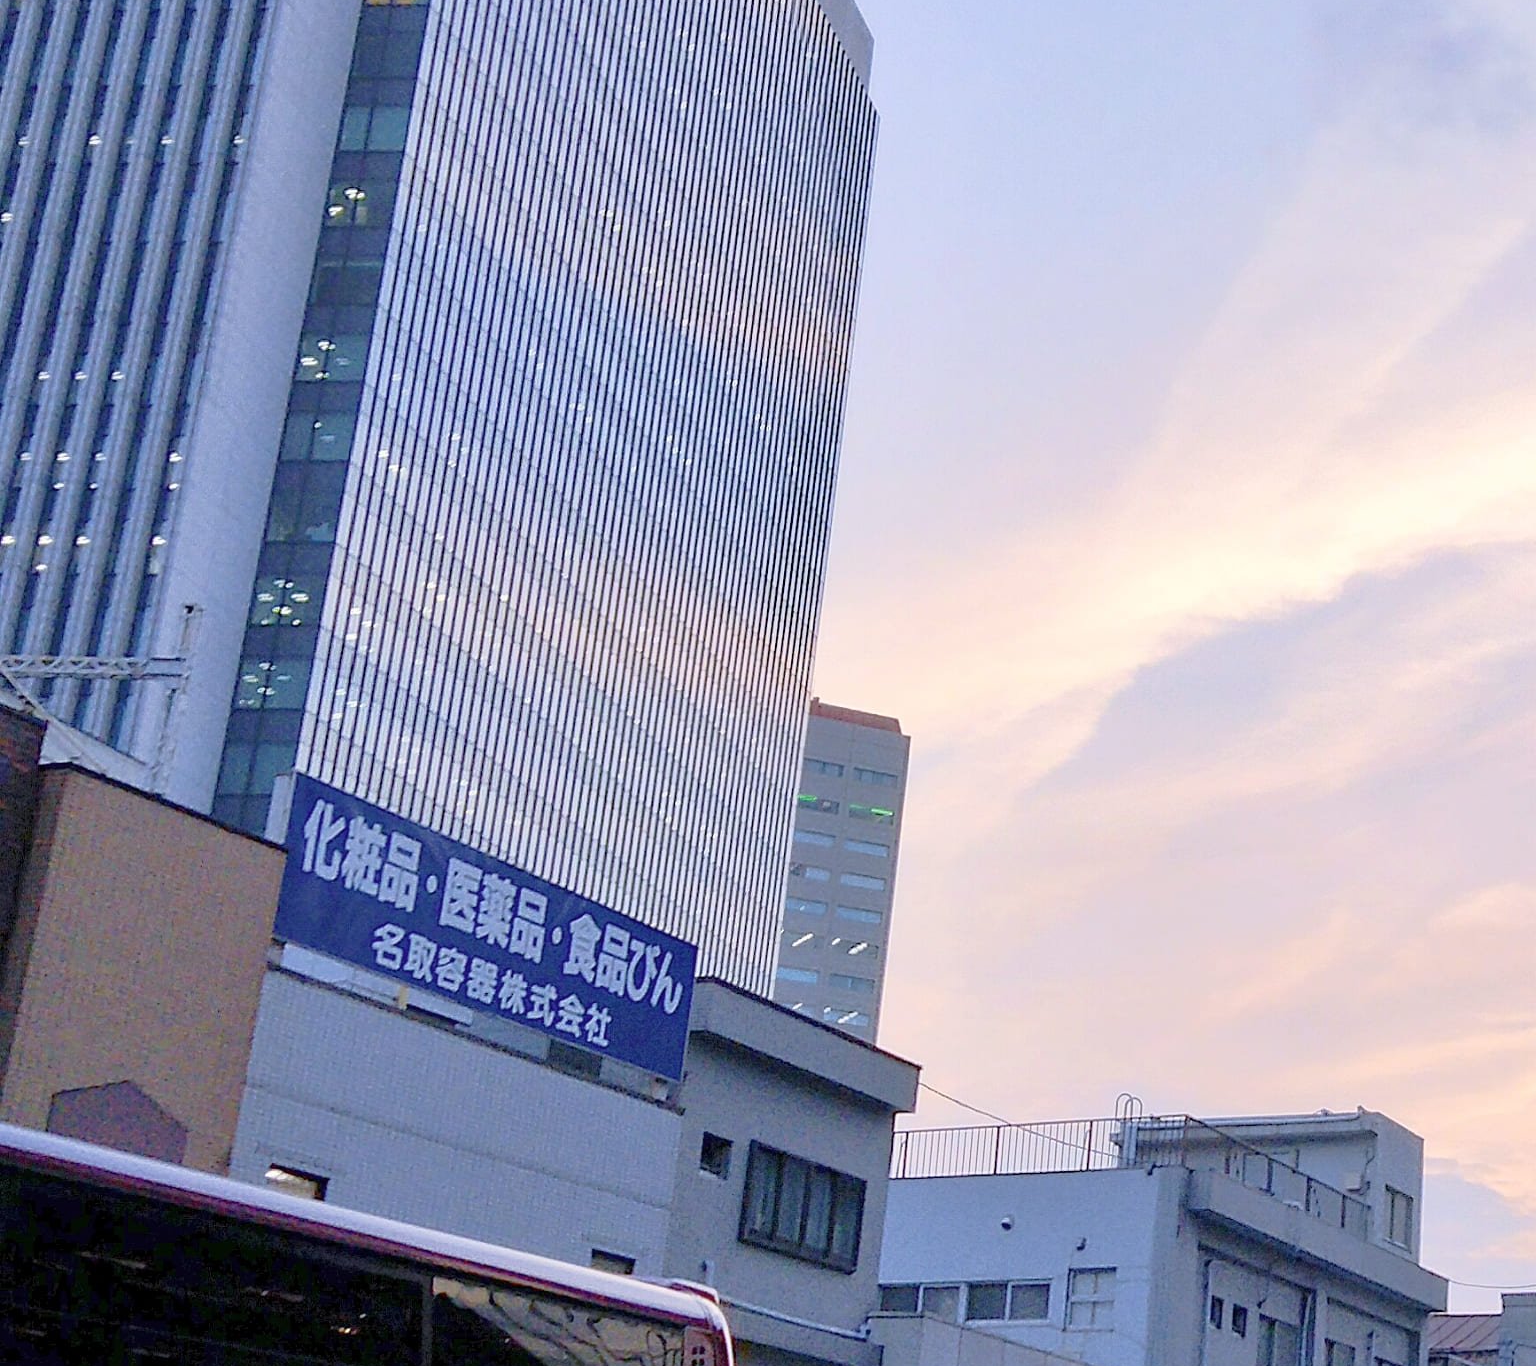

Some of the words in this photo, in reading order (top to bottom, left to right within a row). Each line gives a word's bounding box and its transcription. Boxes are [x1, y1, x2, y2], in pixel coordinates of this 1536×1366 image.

[371, 923, 612, 1047] 名取容器株式会社
